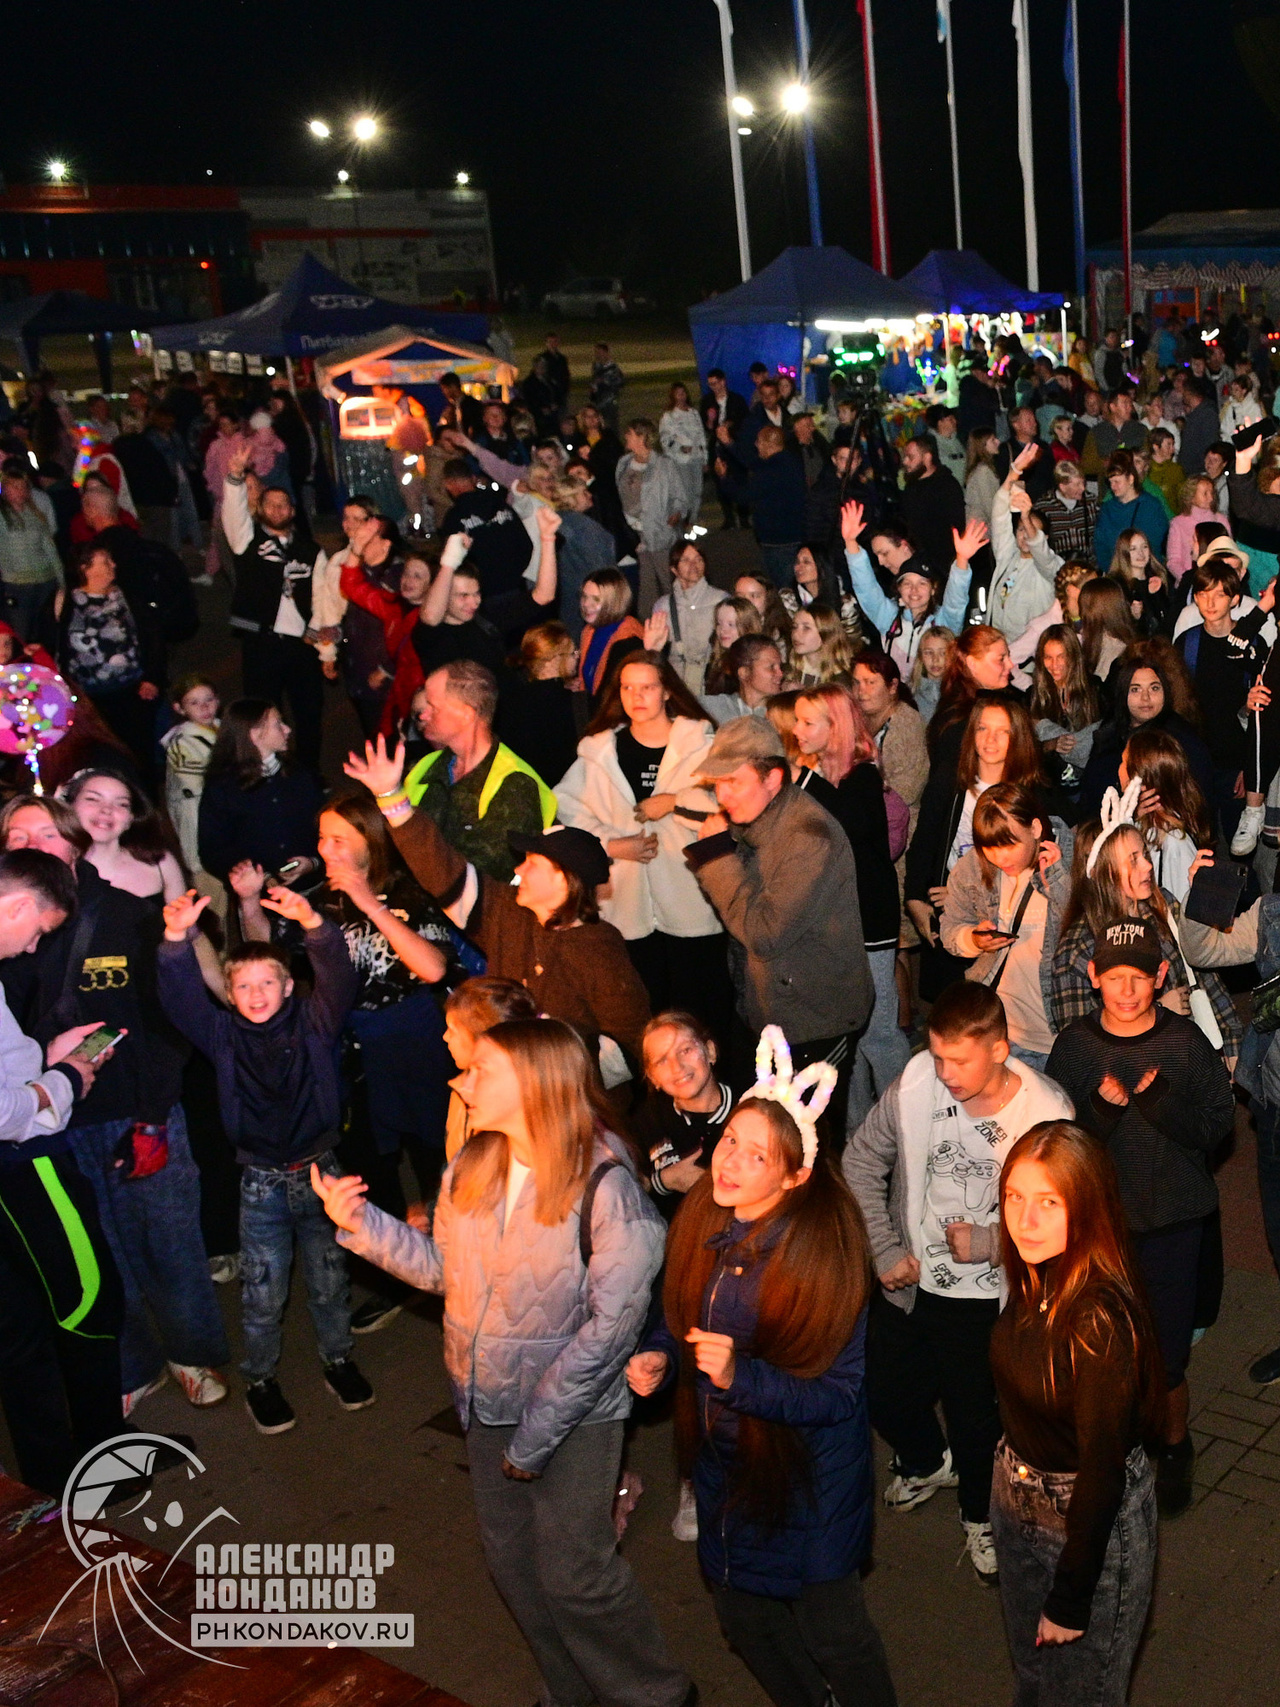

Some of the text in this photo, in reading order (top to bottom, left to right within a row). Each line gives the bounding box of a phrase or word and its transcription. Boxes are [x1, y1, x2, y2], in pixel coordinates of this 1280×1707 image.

[1106, 923, 1145, 941] NEW YORK
[1113, 931, 1136, 946] CITY
[974, 1123, 1002, 1148] ZONE
